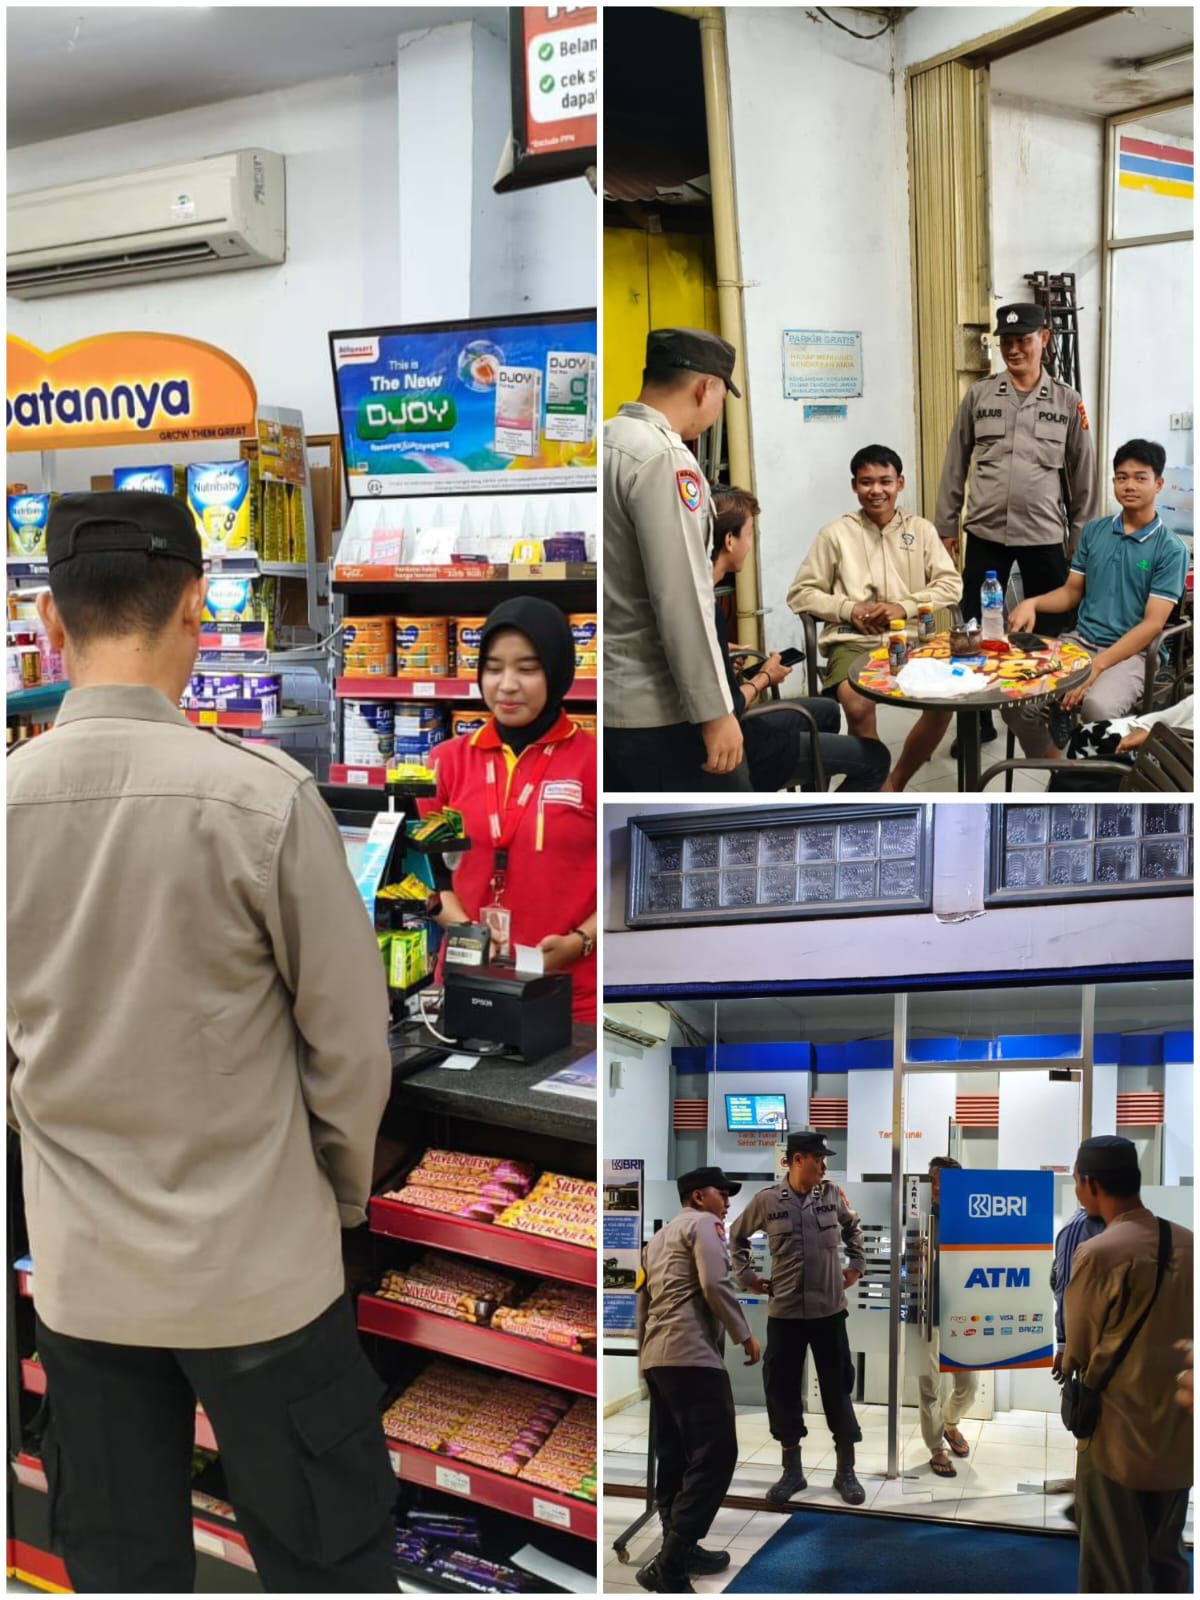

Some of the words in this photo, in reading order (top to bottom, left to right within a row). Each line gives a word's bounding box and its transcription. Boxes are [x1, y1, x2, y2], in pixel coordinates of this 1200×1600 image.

[561, 70, 585, 88] cek
[588, 68, 597, 83] s
[562, 91, 597, 110] dapa
[789, 335, 822, 344] PARKIR
[824, 335, 856, 345] GRATIS
[389, 359, 409, 370] This
[410, 359, 419, 370] is
[549, 357, 585, 369] DJOY
[370, 376, 400, 392] The
[404, 373, 443, 390] New
[500, 371, 532, 384] DJOY
[366, 400, 449, 427] DJOY
[976, 408, 1002, 419] JULIUS
[1038, 411, 1068, 424] POLRI
[159, 429, 189, 441] GROW
[192, 428, 216, 439] THEM
[217, 426, 247, 437] GREAT
[193, 481, 241, 492] Nutribaby
[472, 998, 493, 1007] EPSON
[623, 1160, 641, 1170] BRI
[554, 1177, 597, 1198] SILVER
[992, 1196, 1027, 1217] BRI
[964, 1268, 1030, 1288] ATM
[1019, 1326, 1043, 1334] BRIZZI
